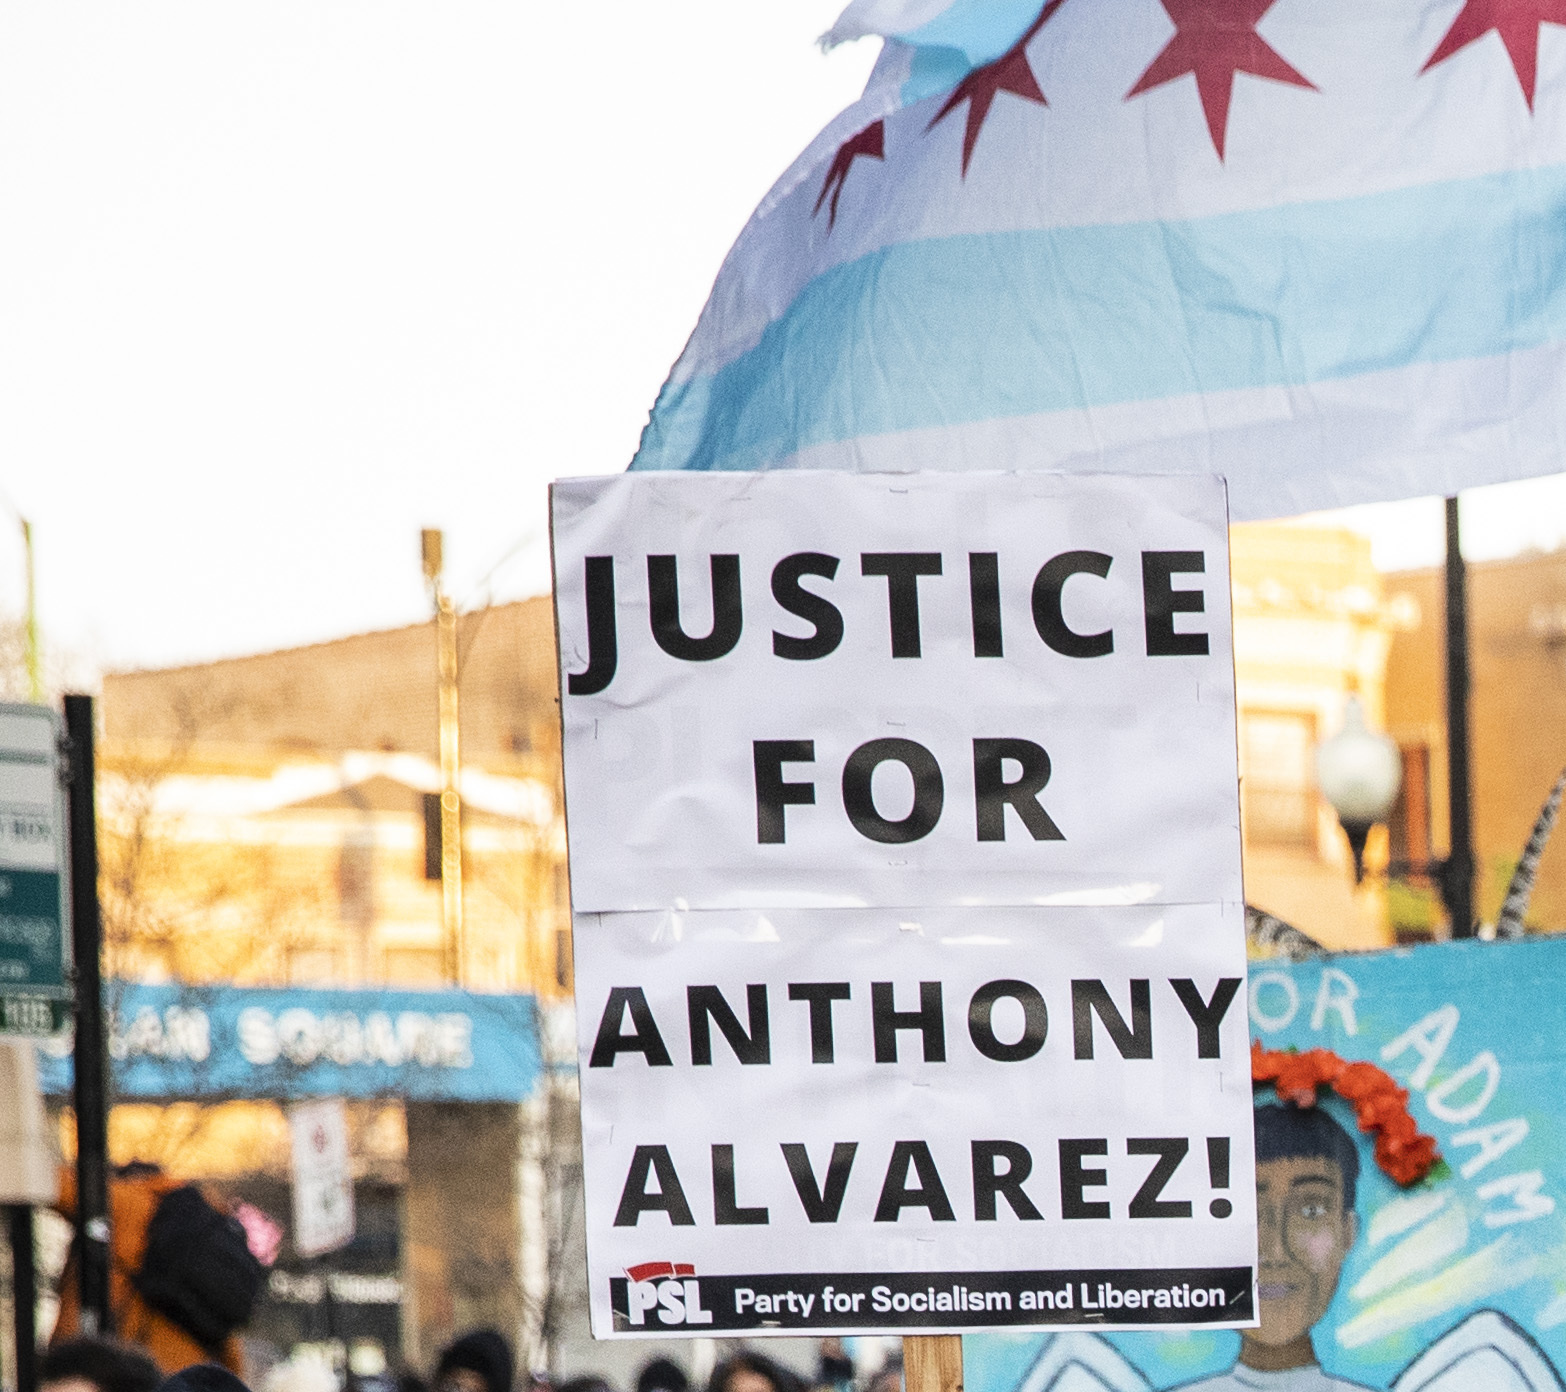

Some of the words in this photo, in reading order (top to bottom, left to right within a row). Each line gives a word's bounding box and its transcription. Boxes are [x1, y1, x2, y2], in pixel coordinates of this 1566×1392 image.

[568, 551, 1209, 696] JUSTICE
[753, 738, 1065, 844] FOR
[589, 978, 1242, 1068] ANTHONY
[1247, 967, 1360, 1037] OR
[1381, 1005, 1555, 1228] ADAM
[614, 1137, 1232, 1226] ALVAREZ!
[627, 1280, 713, 1326] PSL
[735, 1288, 815, 1317] Party
[822, 1286, 865, 1312] for
[872, 1285, 1011, 1312] Socialism
[1019, 1283, 1073, 1309] and
[1081, 1283, 1225, 1308] Liberation
